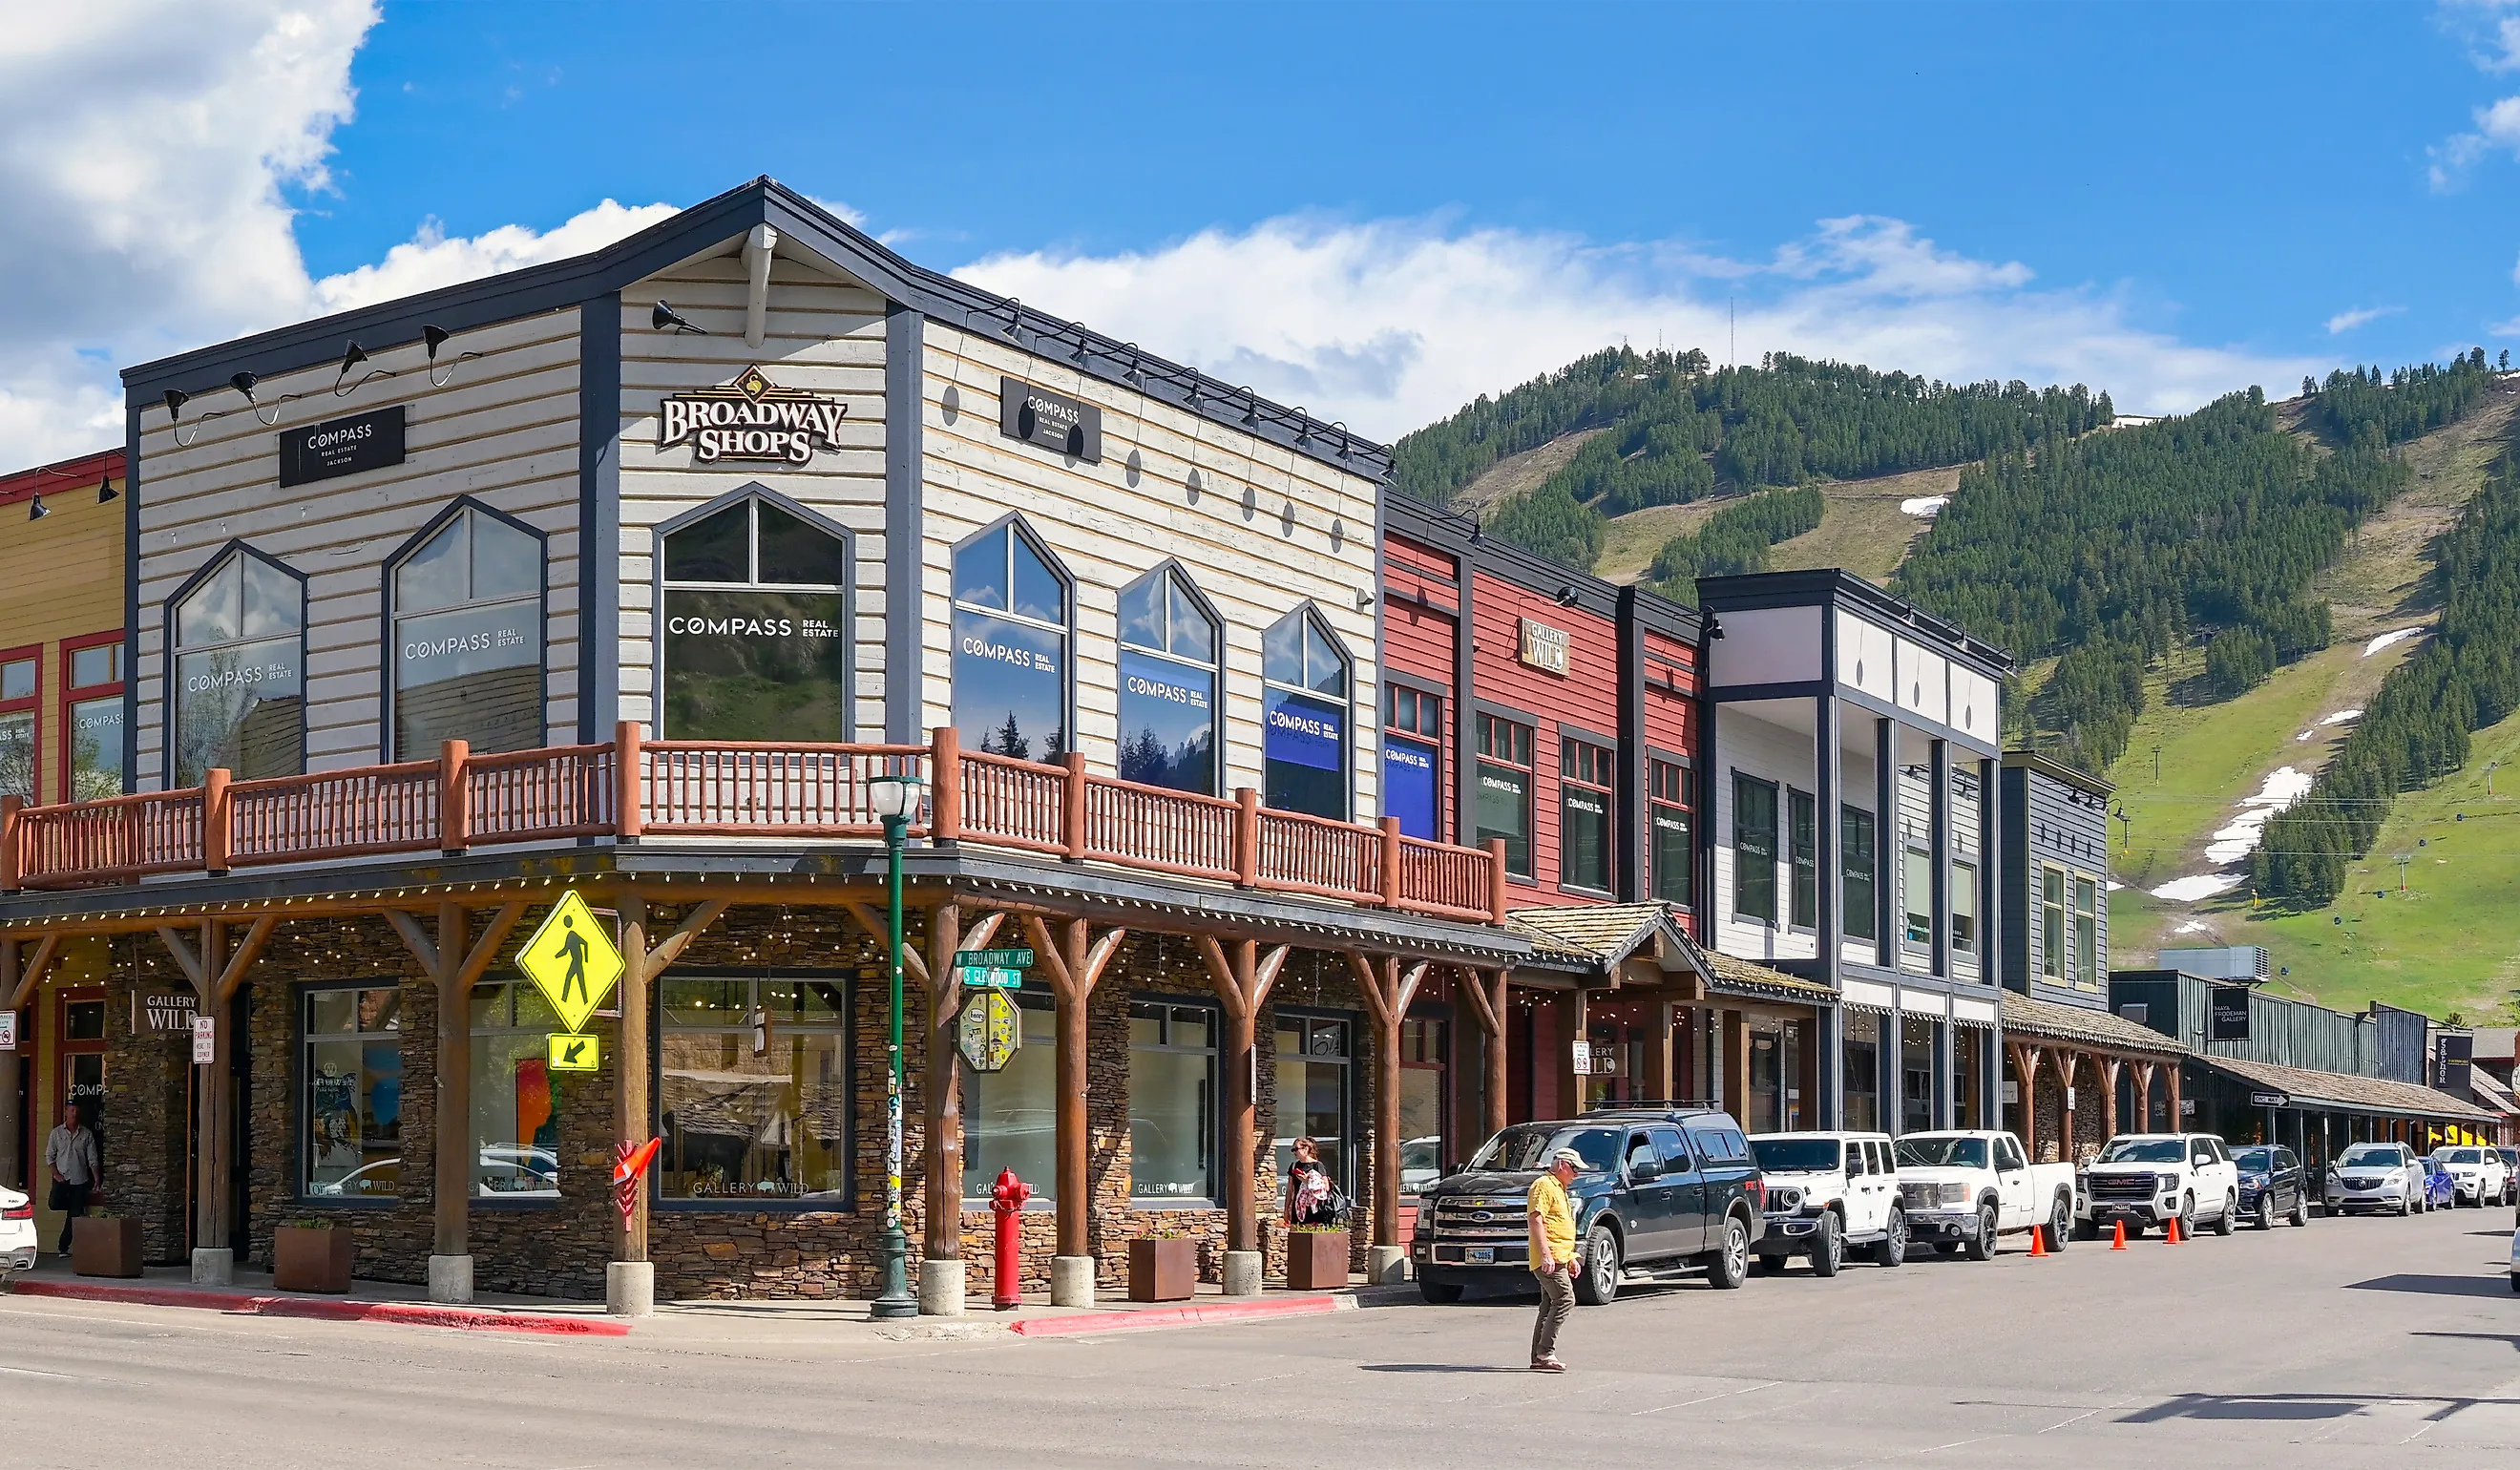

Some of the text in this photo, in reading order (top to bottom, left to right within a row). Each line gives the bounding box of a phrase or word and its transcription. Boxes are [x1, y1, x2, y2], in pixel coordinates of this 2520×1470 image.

[1027, 395, 1080, 425] COMPASS
[662, 400, 848, 447] BROADWAY
[1039, 416, 1068, 431] REAL ESTATE
[307, 424, 373, 450] COMPASS
[1042, 429, 1064, 440] JACKSON
[337, 445, 357, 453] ESTATE
[698, 430, 812, 462] SHOPS
[326, 456, 352, 466] JACKSON
[668, 617, 792, 637] COMPASS
[802, 620, 829, 628] REAL
[497, 628, 516, 639] REAL
[802, 628, 839, 638] ESTATE
[1532, 624, 1563, 645] GALLERY
[405, 632, 491, 660] COMPASS
[497, 636, 524, 647] ESTATE
[963, 637, 1030, 667] COMPASS
[1035, 653, 1050, 663] REAL
[1530, 638, 1564, 669] WILD
[268, 662, 285, 671] REAL
[1035, 662, 1056, 674] ESTATE
[188, 666, 262, 692] COMPASS
[268, 669, 292, 680] ESTATE
[1127, 676, 1186, 704] COMPASS
[1189, 690, 1203, 700] REAL
[1189, 699, 1208, 709] ESTATE
[1270, 710, 1320, 736] COMPASS
[1386, 748, 1418, 766] COMPASS
[1482, 776, 1512, 792] COMPASS
[1568, 797, 1594, 812] COMPASS
[1656, 816, 1680, 830] COMPASS
[956, 951, 1031, 966] W BROADWAY AVE
[965, 968, 971, 982] S
[1013, 972, 1021, 985] ST
[147, 995, 197, 1007] GALLERY
[146, 1008, 198, 1030] WILD
[200, 1020, 208, 1029] NO
[195, 1031, 213, 1040] PARKING
[1589, 1047, 1613, 1056] LERY
[372, 1180, 395, 1191] WILD
[692, 1182, 809, 1194] GALLERY WILD
[1138, 1183, 1168, 1194] GALLERY
